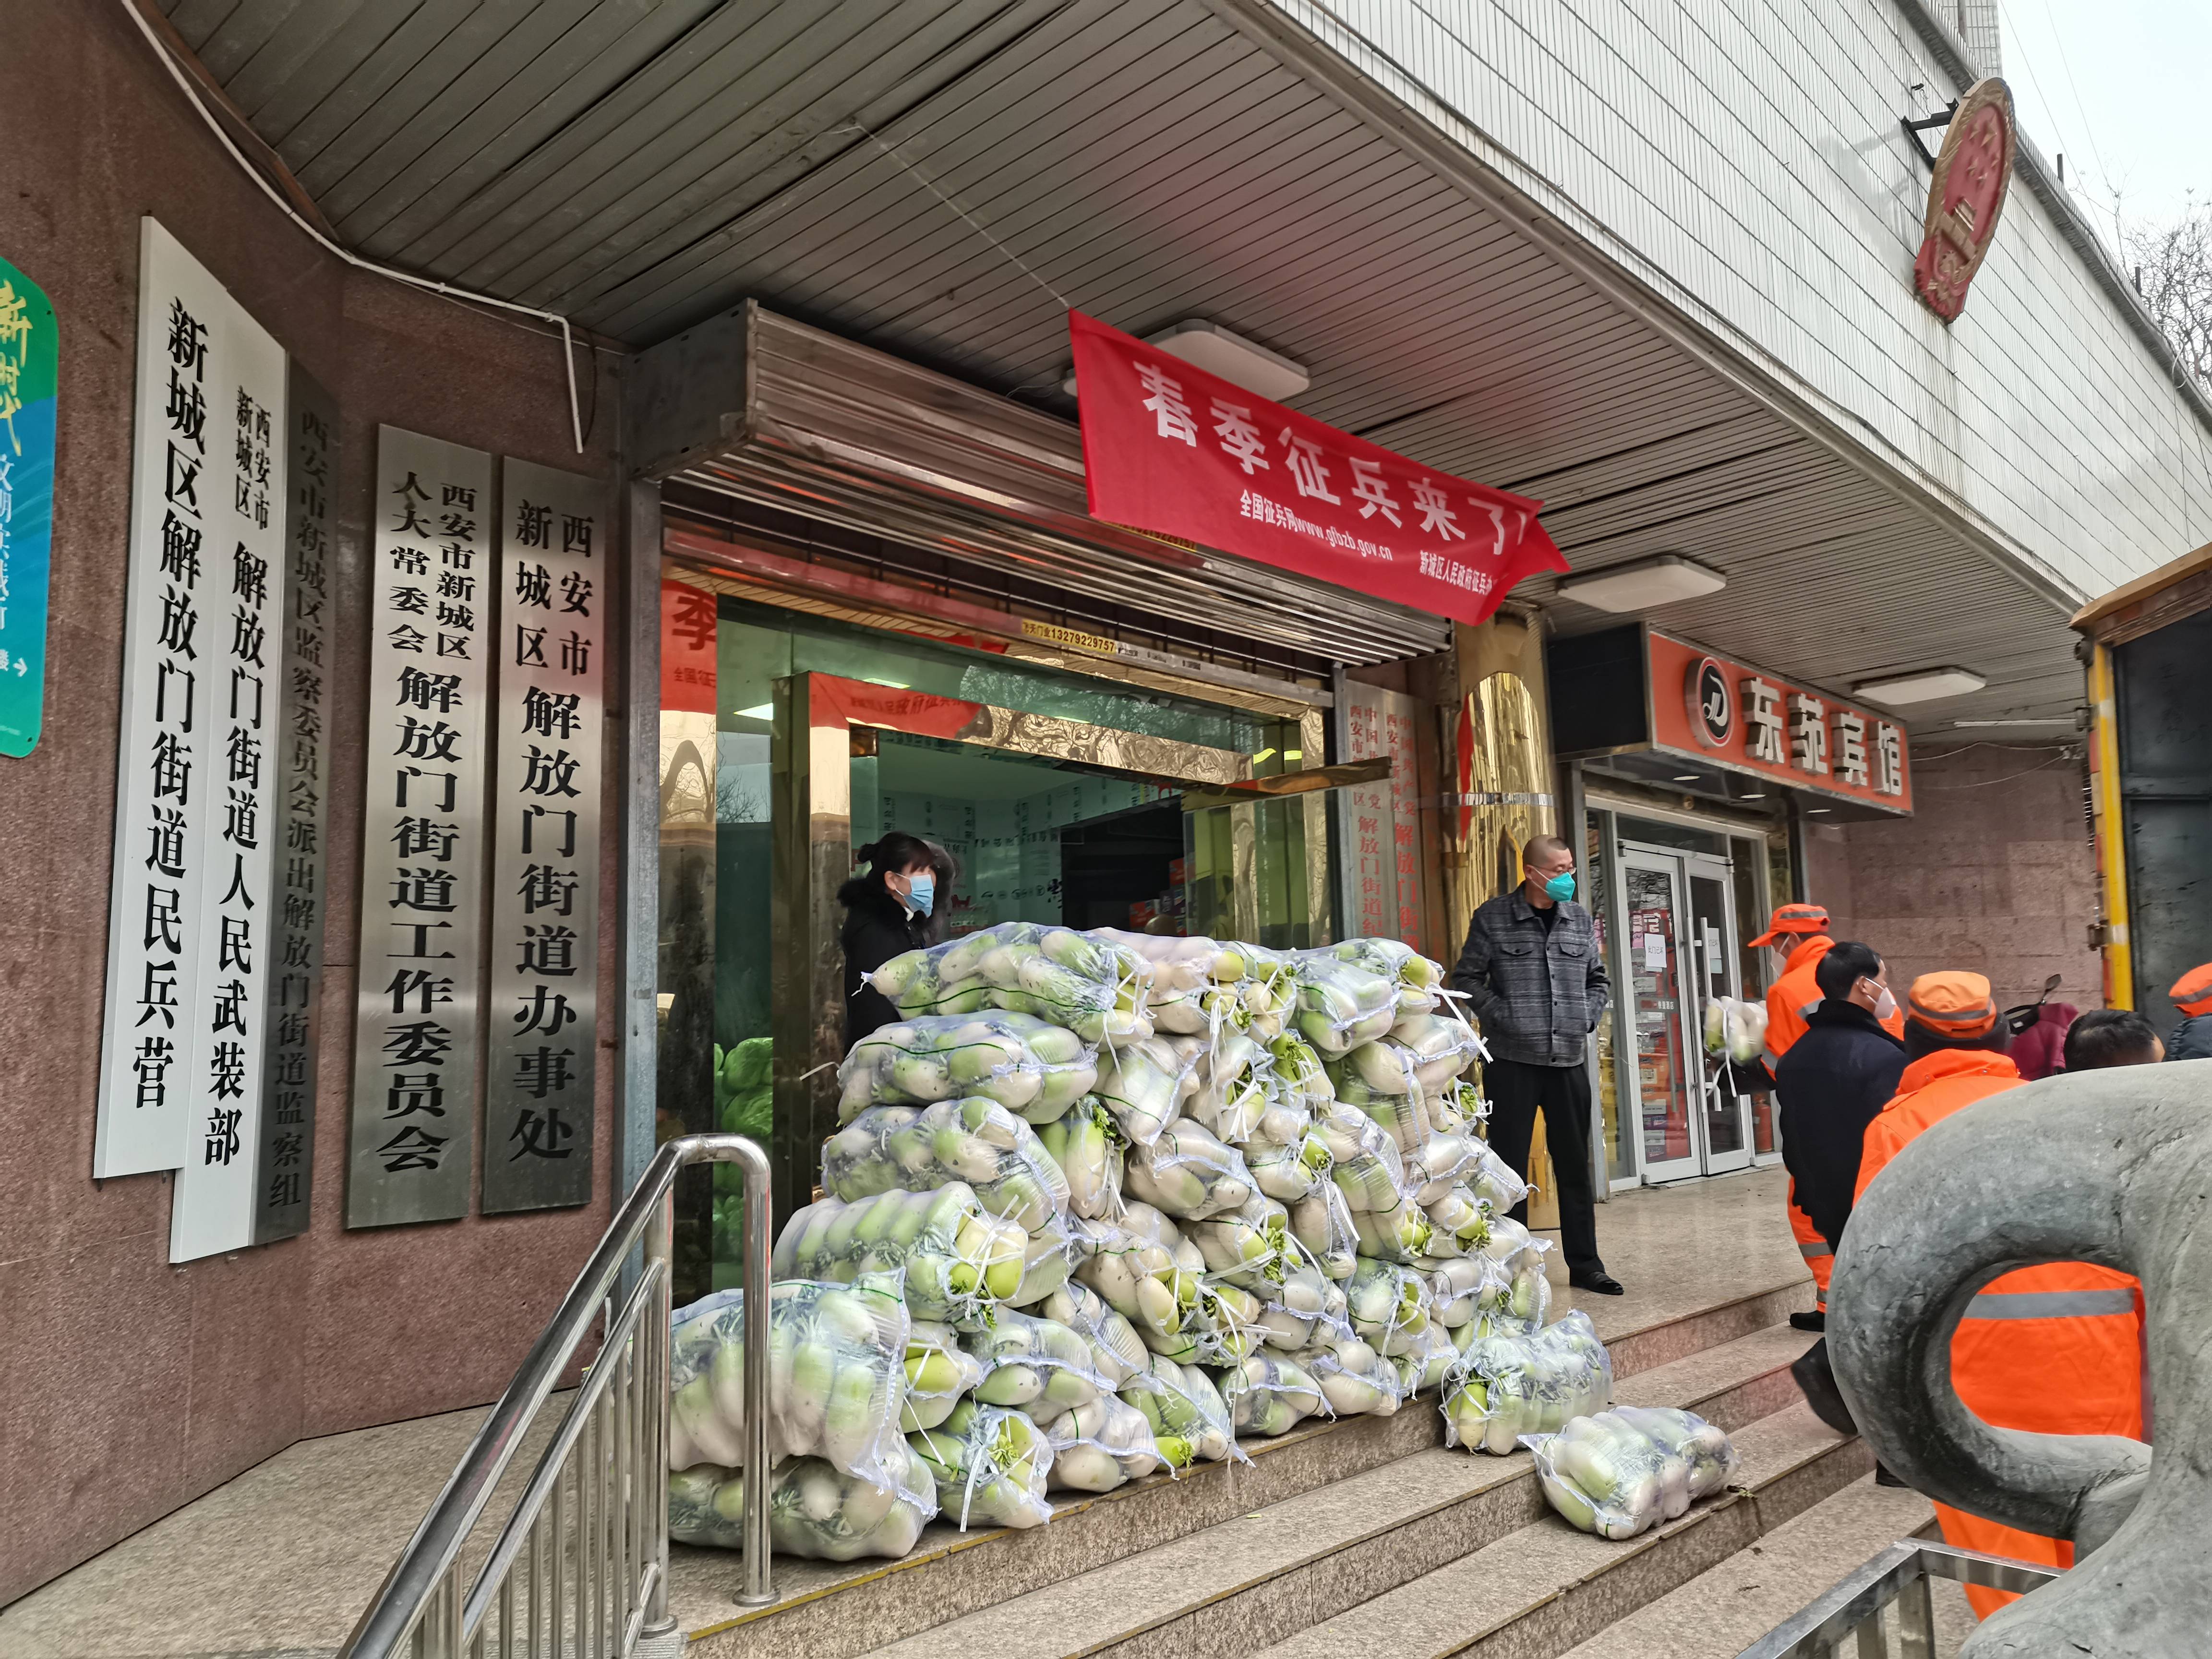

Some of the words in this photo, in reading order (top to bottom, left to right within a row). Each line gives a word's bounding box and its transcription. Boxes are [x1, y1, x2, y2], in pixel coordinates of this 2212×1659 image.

[235, 384, 253, 519] 新城区
[252, 402, 271, 531] 西安市
[386, 471, 433, 653] 人大常委会
[435, 482, 478, 661] 西安市新城区
[515, 499, 553, 668] 新城区
[559, 513, 594, 676] 西安市
[133, 296, 209, 1108] 新城区解放门街道民兵营
[1742, 676, 1903, 796] 东苑宾馆
[205, 541, 268, 1167] 解放门街道人民武装部
[375, 666, 463, 1173] 解放门街道工作委员会
[508, 685, 583, 1163] 解放门街道办事处
